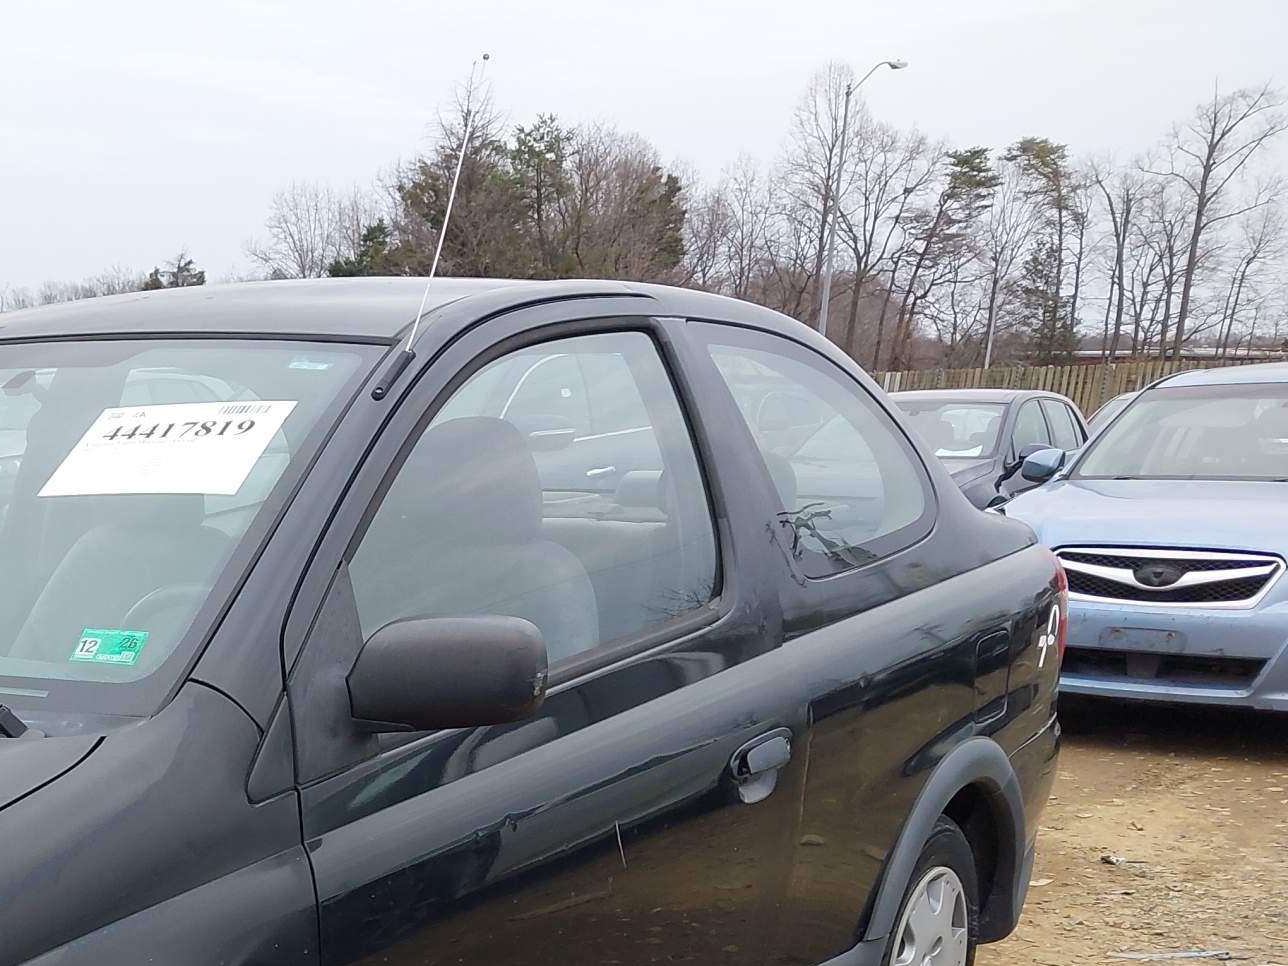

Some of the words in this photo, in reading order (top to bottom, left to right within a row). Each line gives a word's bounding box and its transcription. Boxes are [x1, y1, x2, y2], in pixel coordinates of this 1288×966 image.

[102, 419, 256, 441] 44417819
[79, 639, 99, 654] 12
[119, 636, 139, 650] 26
